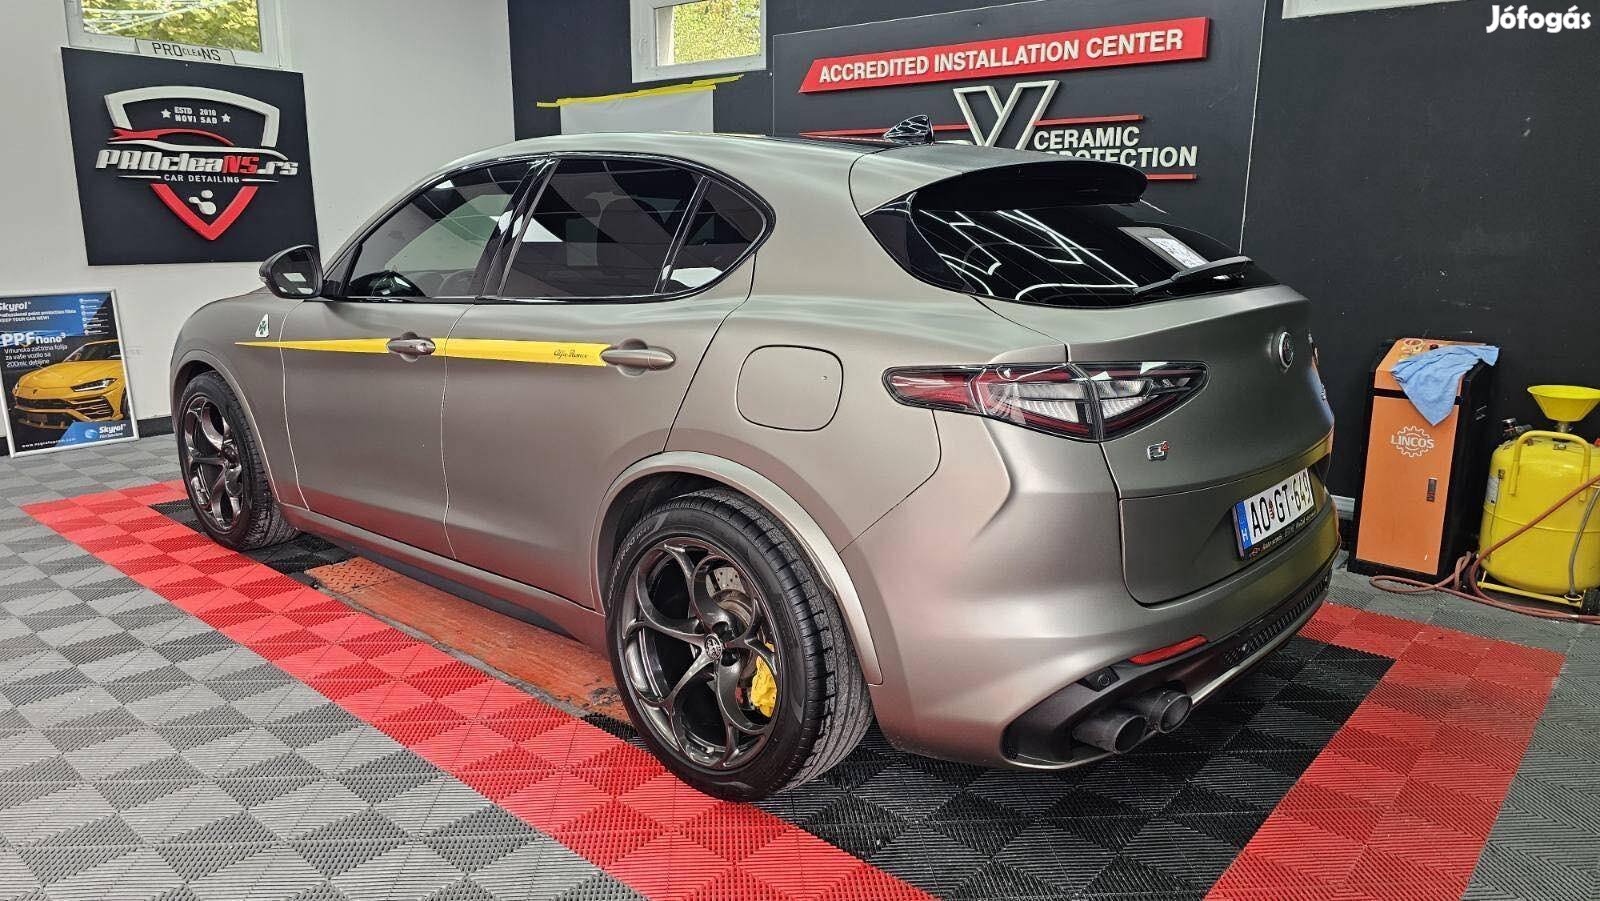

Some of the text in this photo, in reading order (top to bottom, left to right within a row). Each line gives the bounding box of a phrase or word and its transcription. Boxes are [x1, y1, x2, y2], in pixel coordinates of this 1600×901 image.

[819, 28, 1184, 84] ACCREDITED INSTALLATION CENTER
[175, 114, 218, 124] NOVI SAD
[1033, 126, 1140, 151] CERAMIC
[164, 174, 240, 184] CAR DETAILING
[1390, 434, 1435, 449] LINCOS
[1250, 496, 1271, 538] AO
